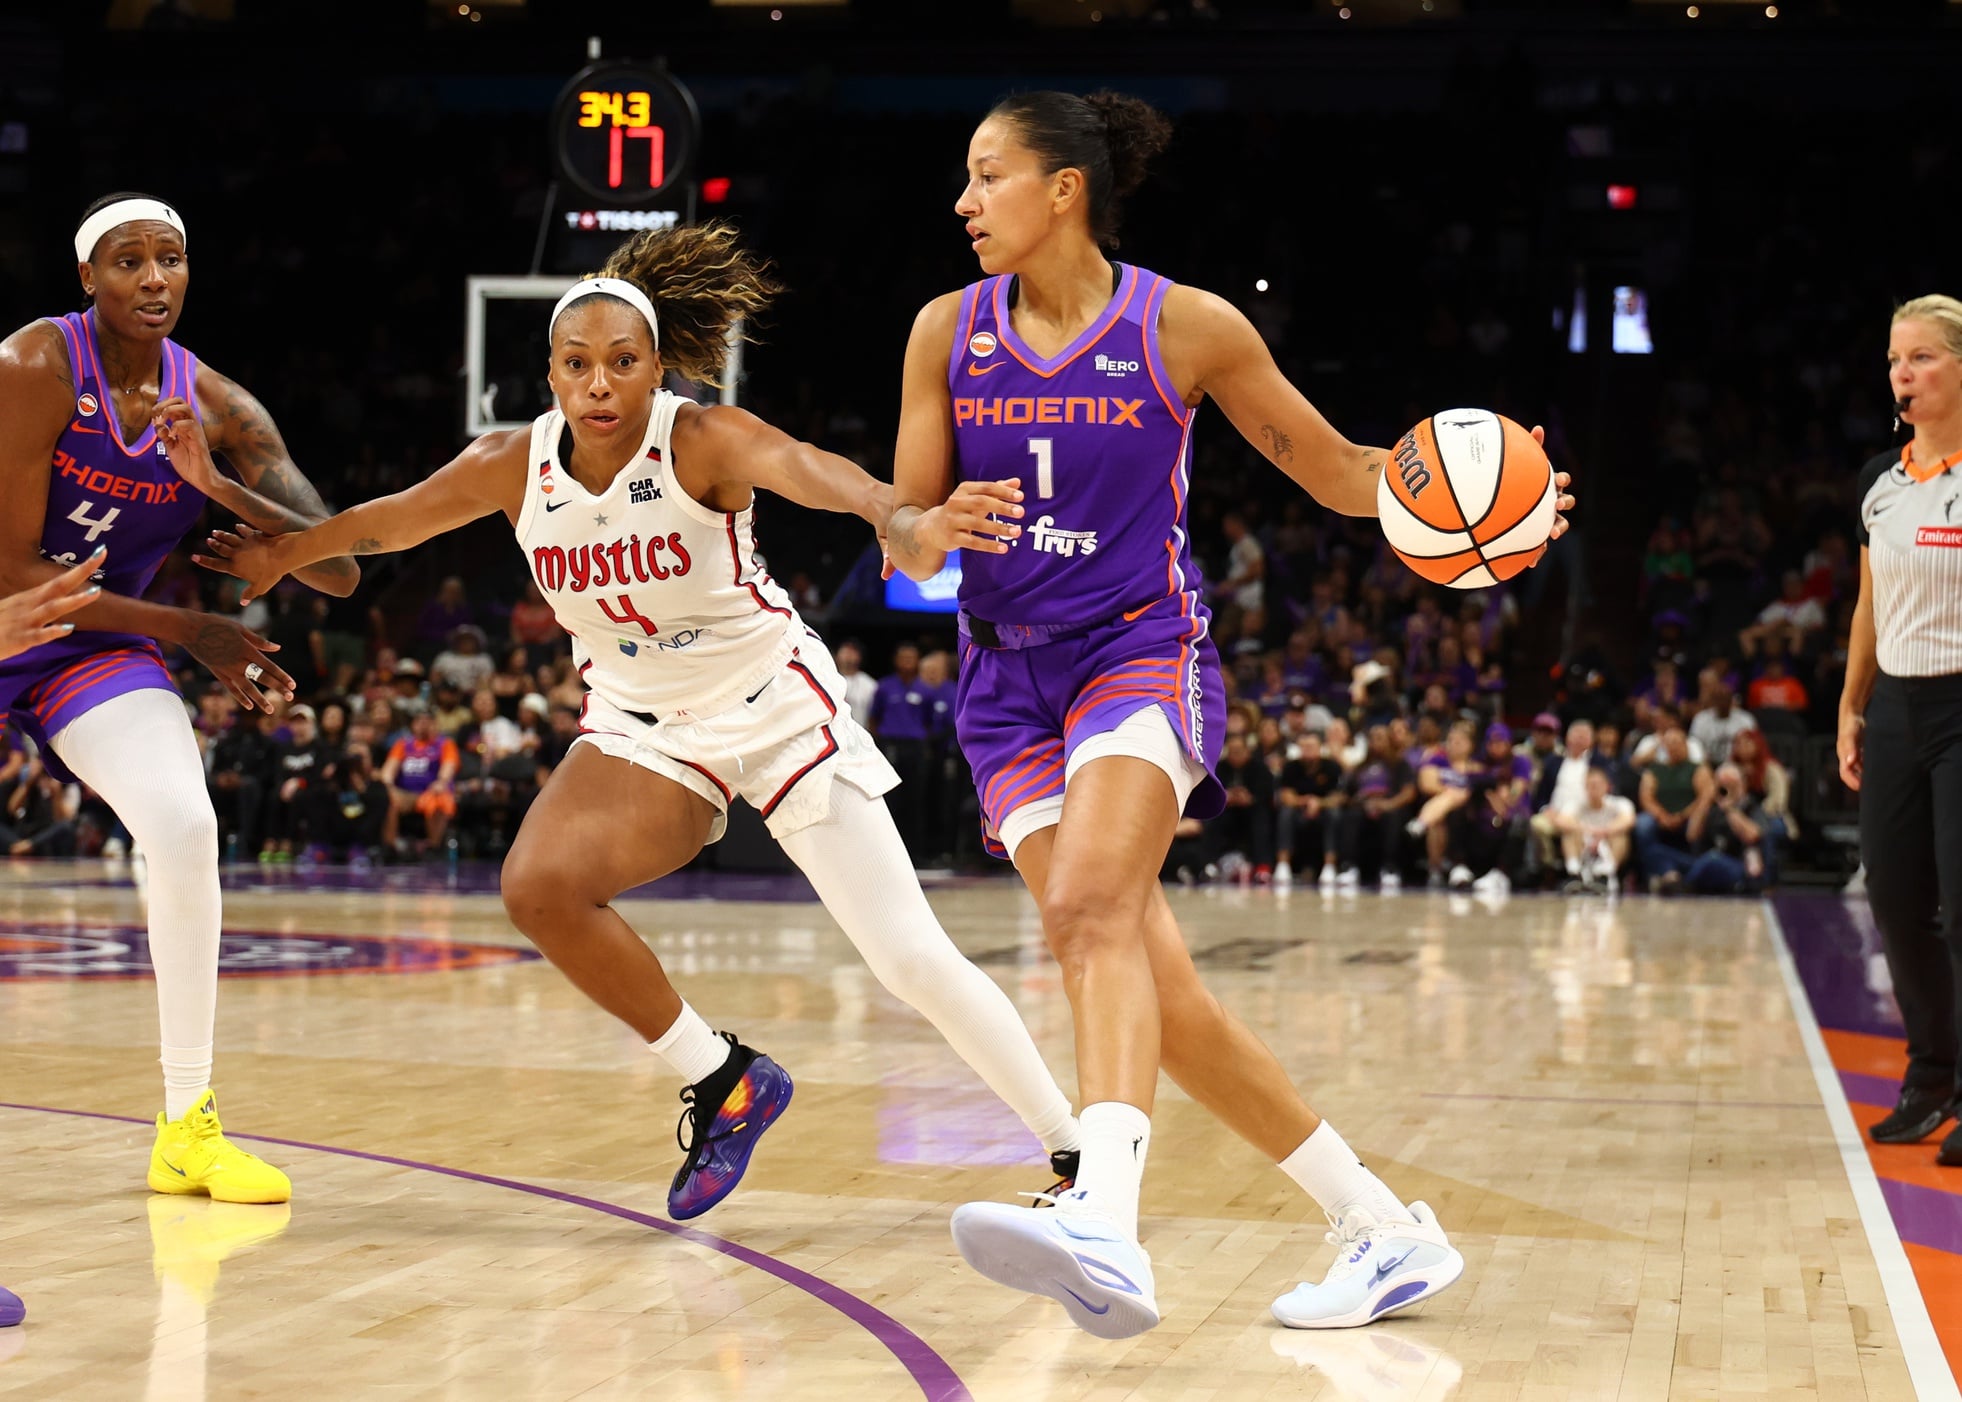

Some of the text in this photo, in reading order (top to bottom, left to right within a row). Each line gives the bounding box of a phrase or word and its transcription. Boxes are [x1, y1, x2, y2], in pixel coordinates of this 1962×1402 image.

[578, 91, 650, 128] 34.3
[608, 126, 664, 188] 17
[1095, 354, 1139, 372] HERO
[954, 397, 1146, 429] PHOENIX
[52, 449, 183, 504] PHOENIX
[629, 478, 654, 492] CAR
[1028, 437, 1054, 499] 1
[631, 488, 662, 504] max
[67, 500, 122, 542] 4
[1917, 530, 1962, 544] Emirate
[596, 594, 658, 636] 4
